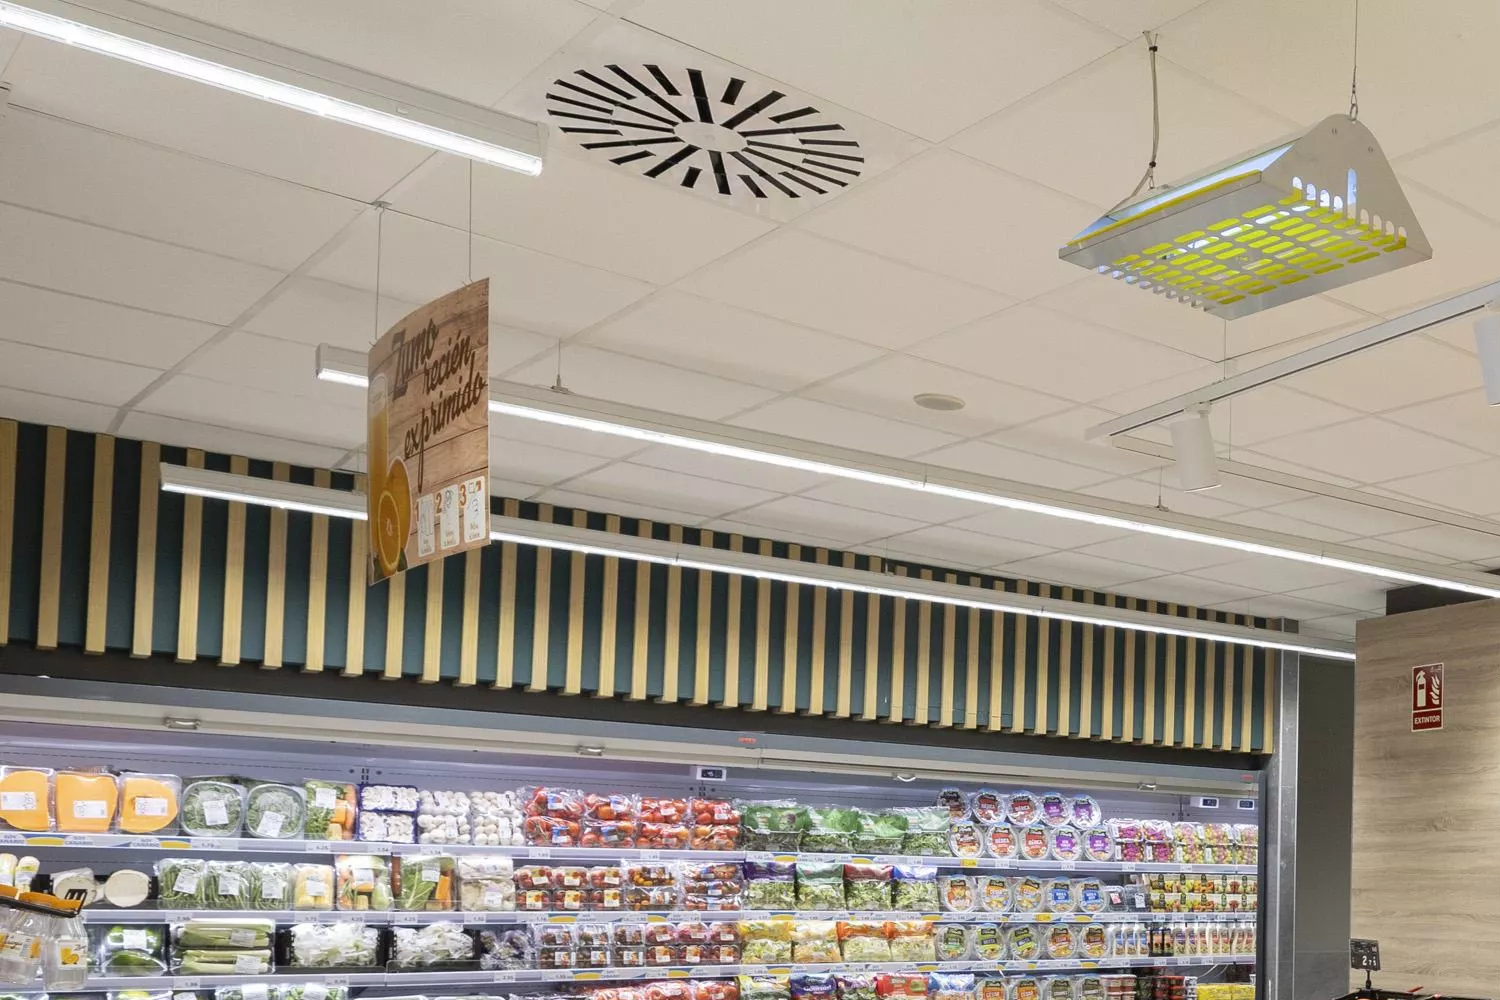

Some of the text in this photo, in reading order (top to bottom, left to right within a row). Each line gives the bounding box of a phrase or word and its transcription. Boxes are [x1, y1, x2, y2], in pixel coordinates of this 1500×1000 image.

[392, 318, 440, 400] Zumo
[423, 329, 473, 395] recién
[404, 351, 488, 493] exprimido
[436, 493, 443, 516] 2
[459, 484, 467, 506] 3
[414, 499, 421, 523] 1
[1414, 715, 1441, 725] EXTINTOR
